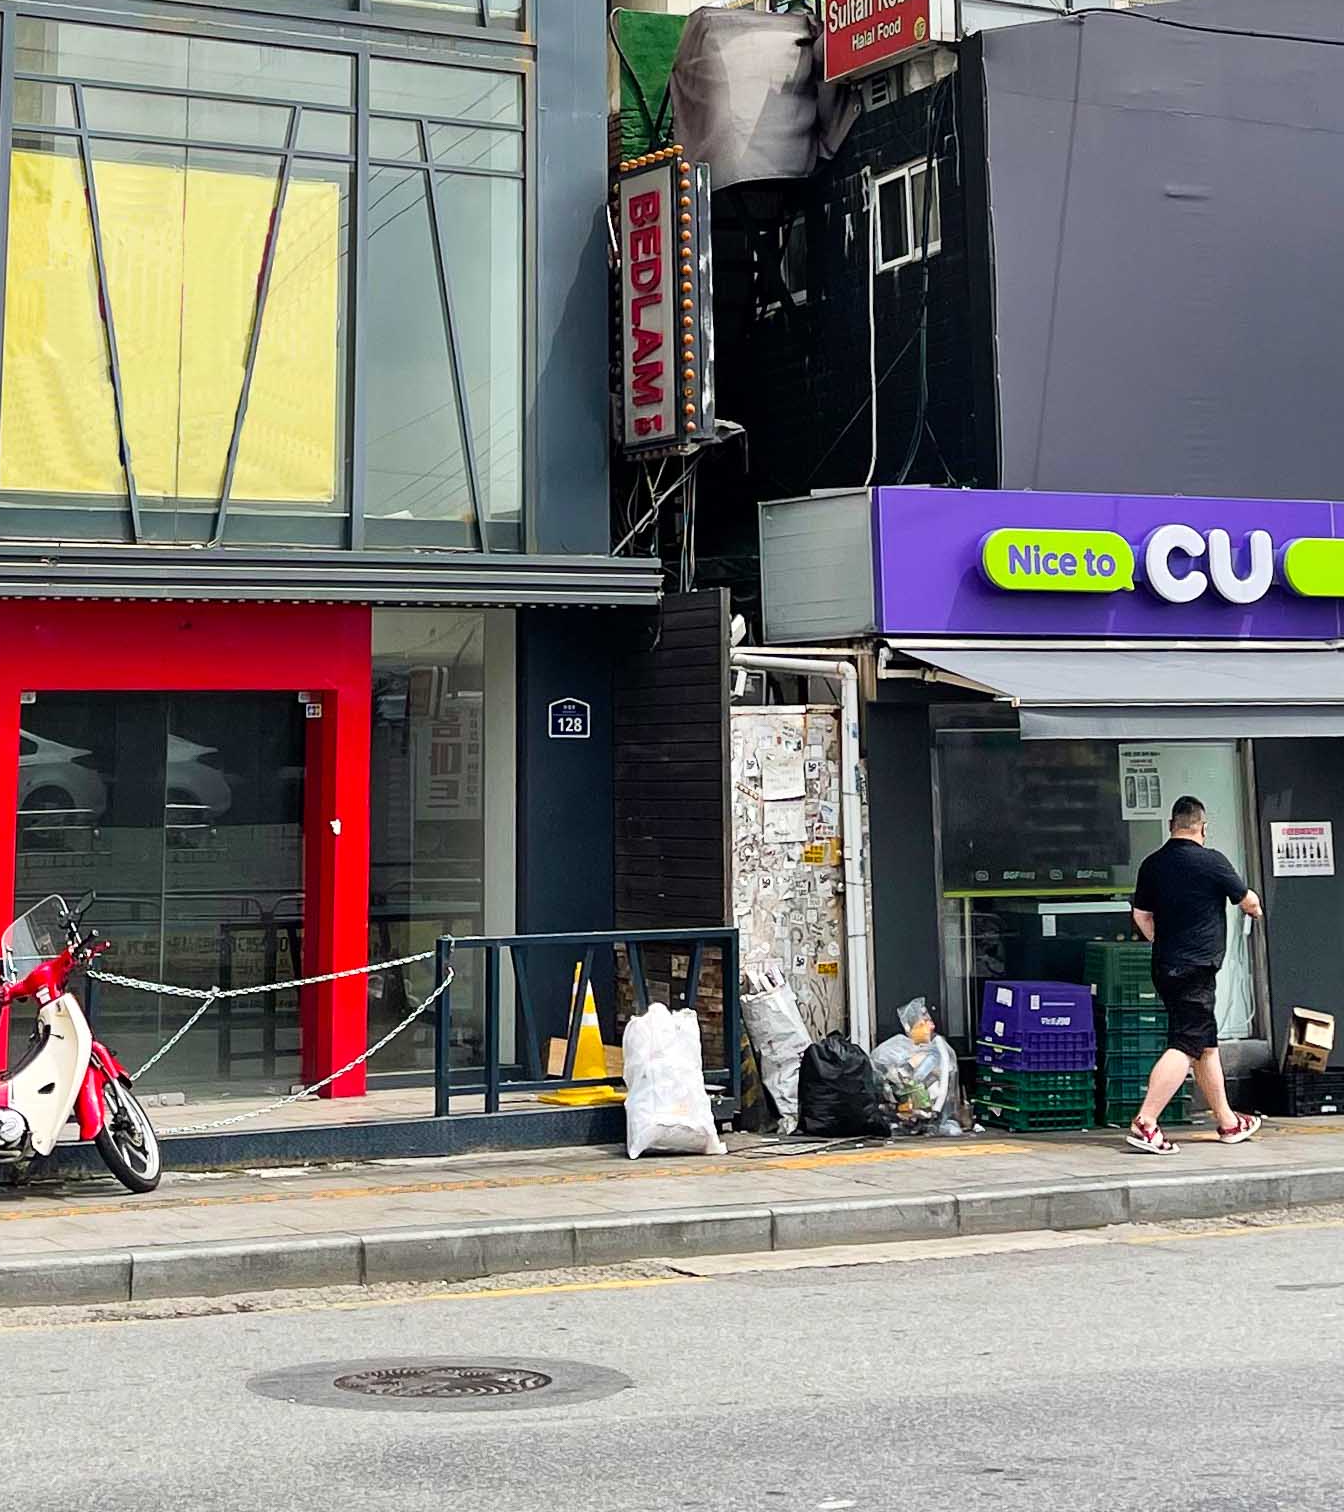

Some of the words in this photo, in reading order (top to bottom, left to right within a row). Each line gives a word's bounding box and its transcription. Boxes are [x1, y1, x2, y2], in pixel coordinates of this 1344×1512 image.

[852, 29, 875, 52] Halal
[877, 16, 902, 41] Food
[629, 189, 664, 407] BEDLAM
[1008, 544, 1078, 576] Nice
[1083, 548, 1116, 576] to
[1144, 523, 1274, 604] CU
[557, 717, 583, 733] 128
